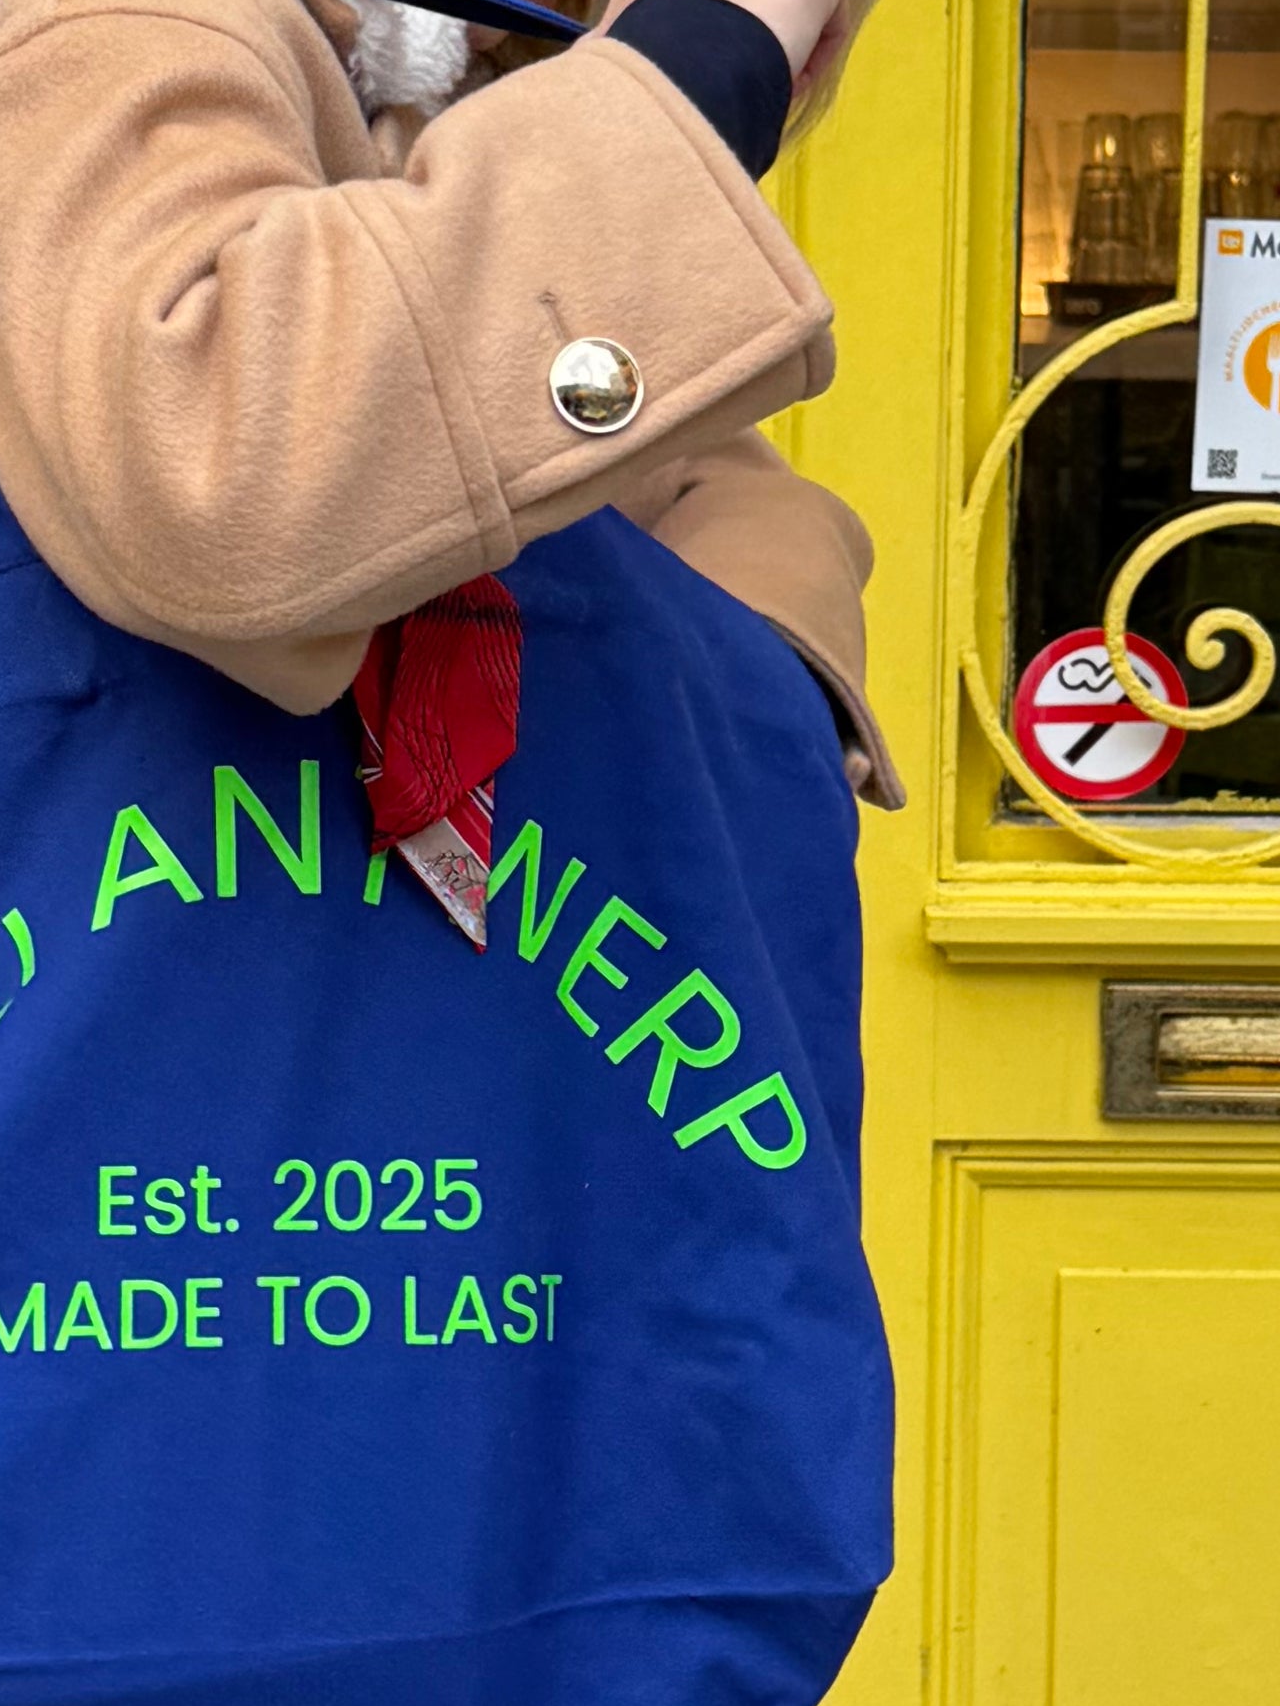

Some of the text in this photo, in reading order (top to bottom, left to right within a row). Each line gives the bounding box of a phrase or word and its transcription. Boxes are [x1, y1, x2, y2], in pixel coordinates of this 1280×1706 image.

[98, 1158, 483, 1237] Est. 2025
[256, 1274, 372, 1346] TO
[404, 1274, 562, 1347] LAST
